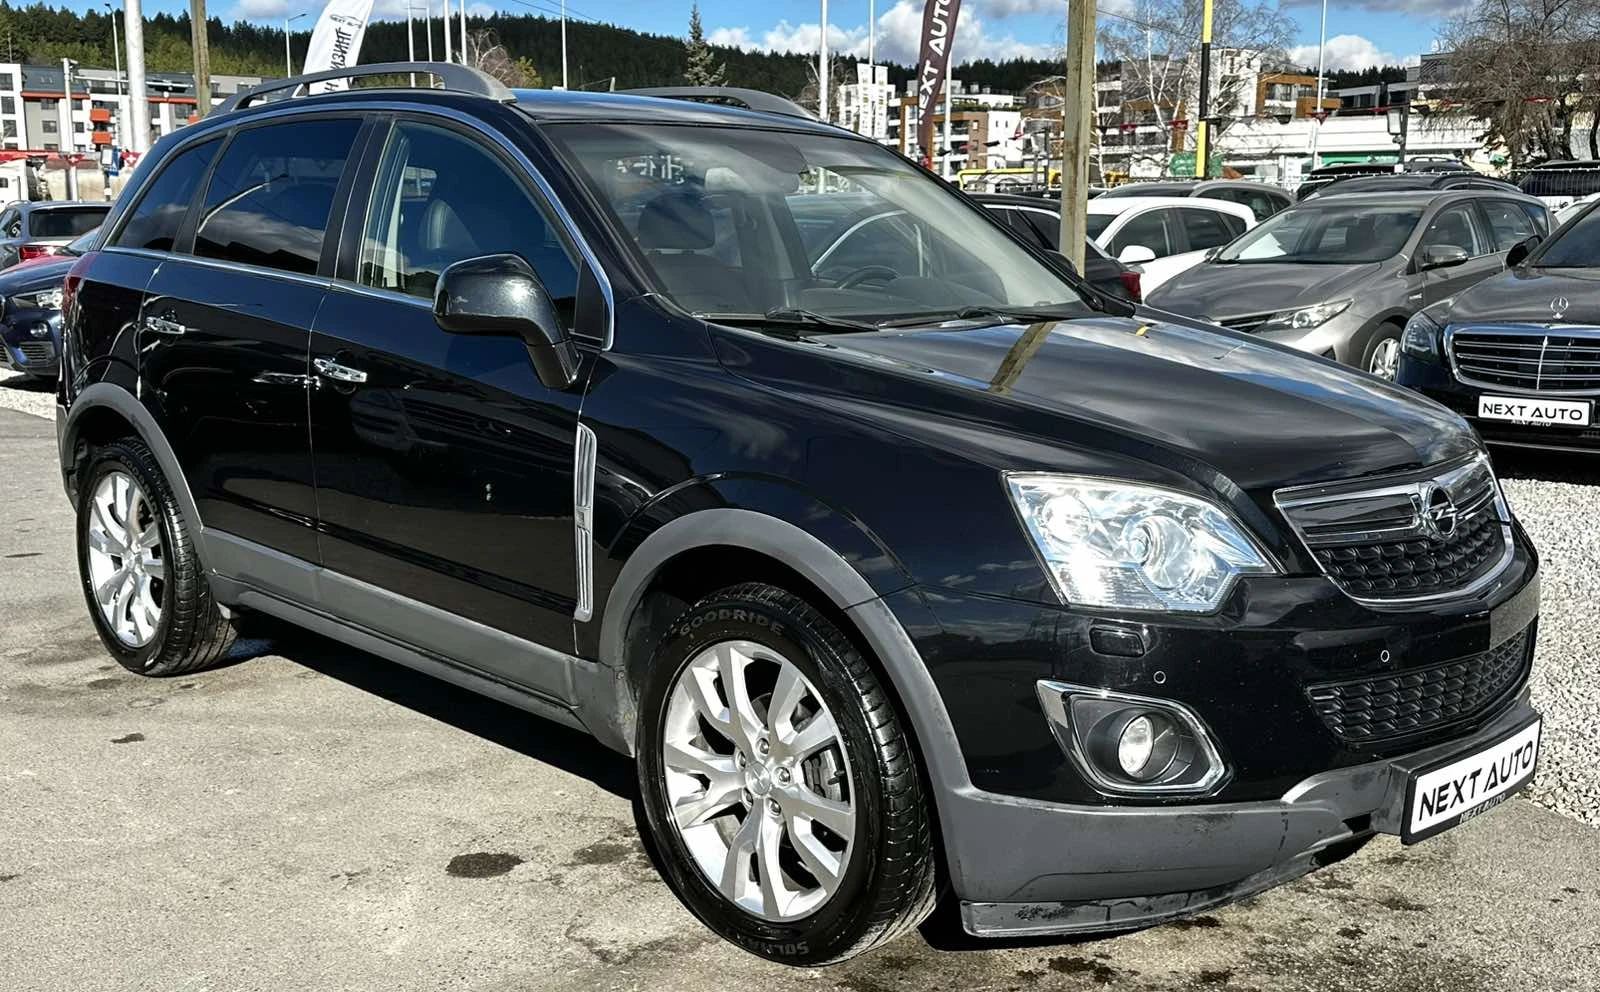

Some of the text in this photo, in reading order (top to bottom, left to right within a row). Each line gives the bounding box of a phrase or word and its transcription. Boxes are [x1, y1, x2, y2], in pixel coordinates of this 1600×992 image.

[329, 27, 352, 74] ИЗИНГ
[1482, 403, 1583, 421] NEXT AUTO
[680, 608, 785, 636] GOODRIDE
[1418, 740, 1534, 822] NEXT AUTO
